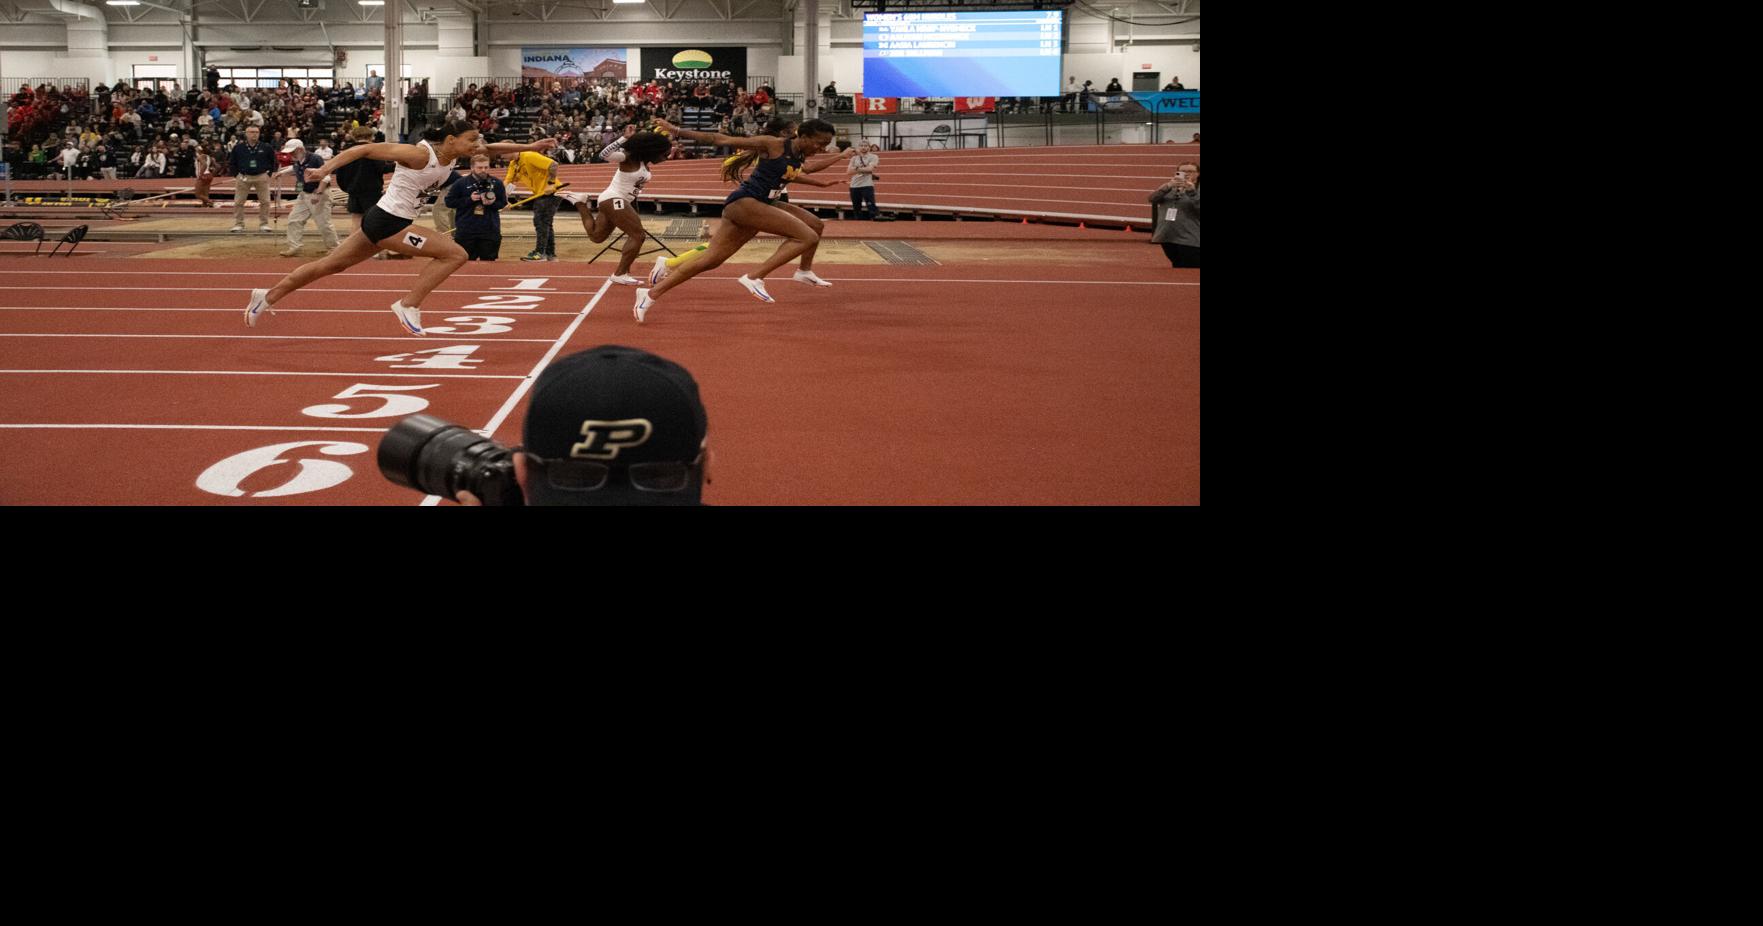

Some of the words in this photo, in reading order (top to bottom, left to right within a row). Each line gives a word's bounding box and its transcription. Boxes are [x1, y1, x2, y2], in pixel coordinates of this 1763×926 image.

[524, 54, 570, 63] INDIANA
[654, 68, 731, 82] Keystone
[868, 97, 887, 110] R
[614, 200, 622, 208] 1
[408, 235, 423, 247] 4
[489, 278, 557, 290] 1
[461, 295, 546, 310] 2
[423, 315, 516, 335] 3
[373, 345, 485, 369] 4
[301, 383, 442, 419] 5
[570, 418, 653, 460] P
[195, 440, 369, 497] 6
